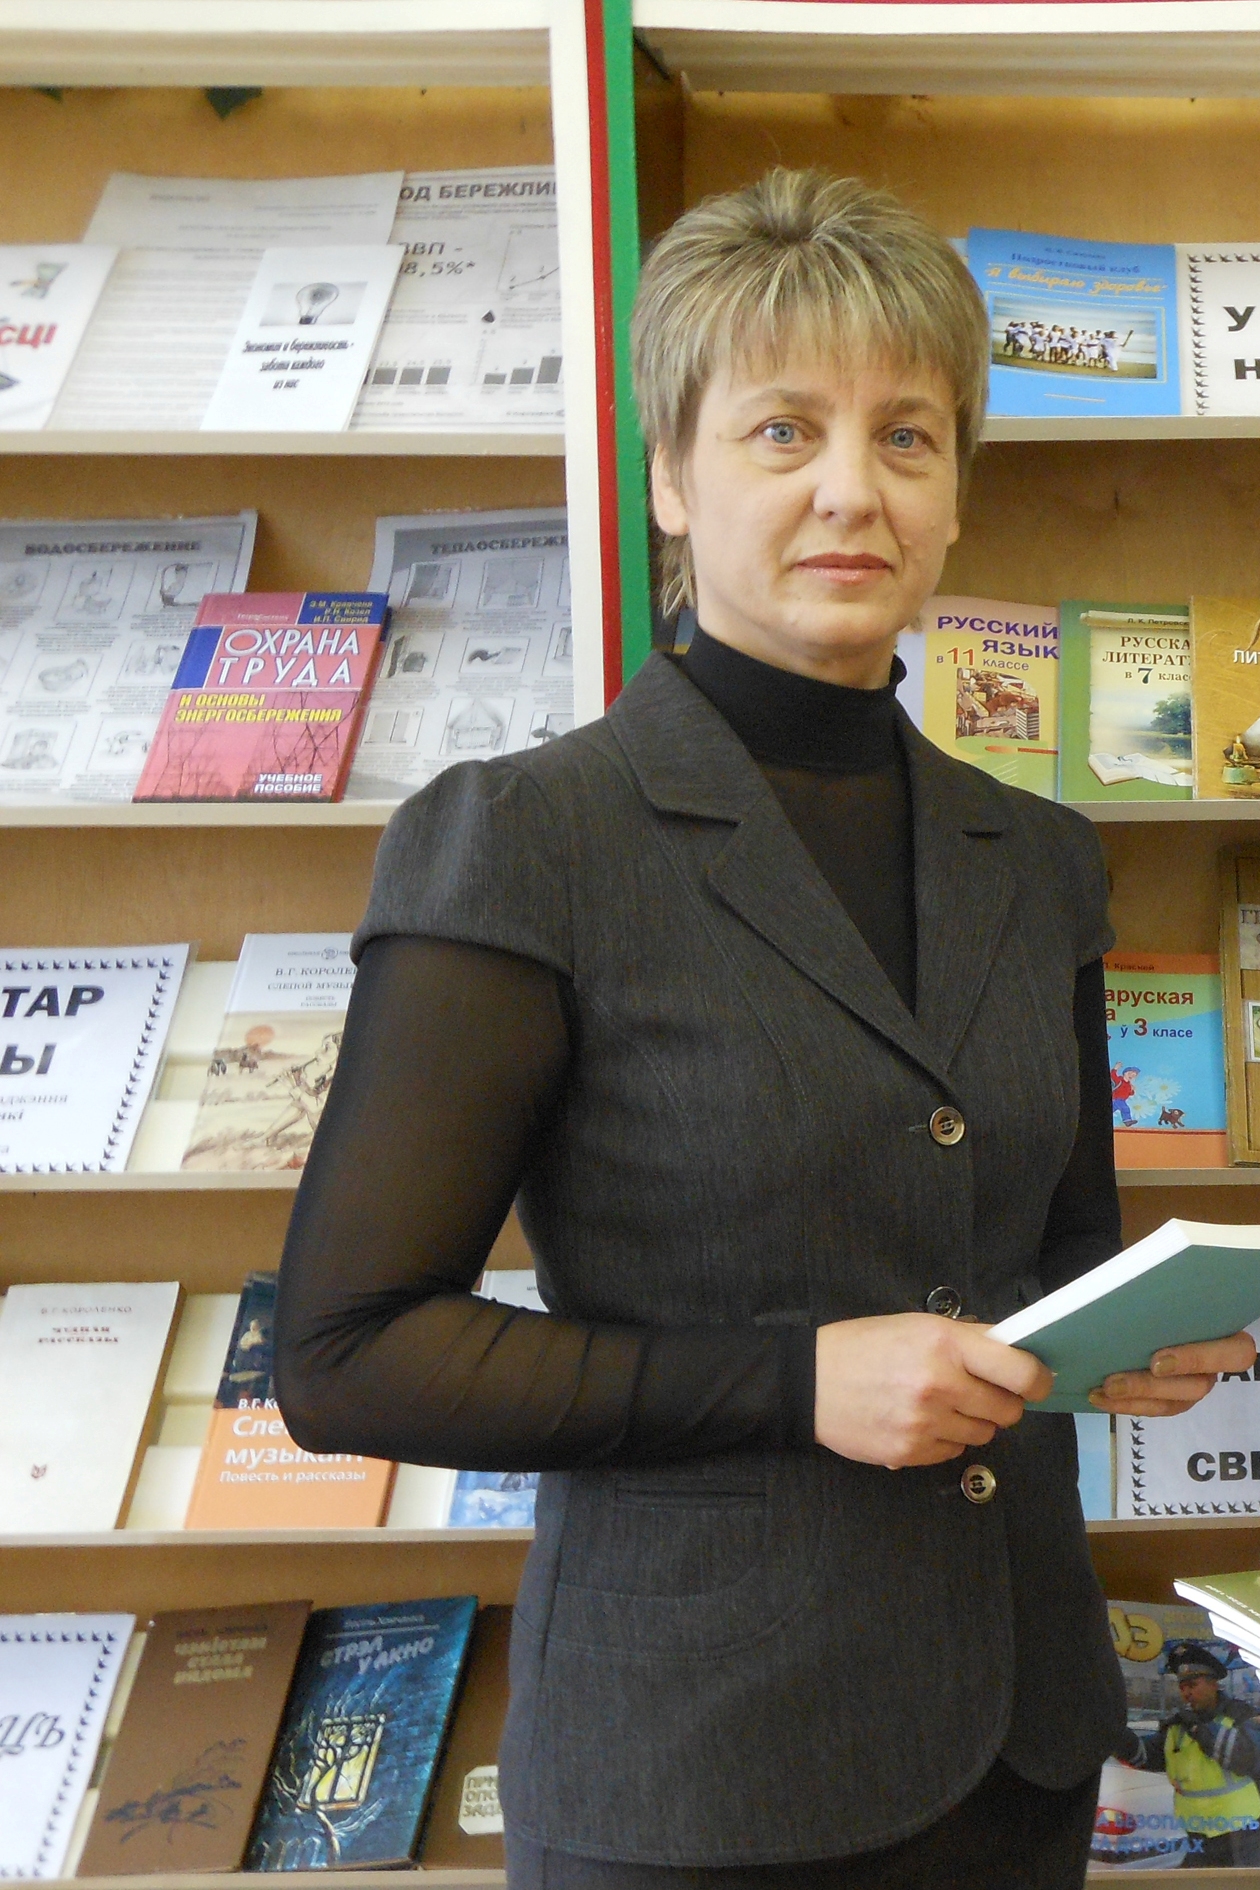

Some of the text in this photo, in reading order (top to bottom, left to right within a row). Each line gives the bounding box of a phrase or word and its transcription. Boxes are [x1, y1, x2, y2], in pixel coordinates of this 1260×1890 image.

[1223, 305, 1258, 332] У
[937, 615, 1058, 639] РУССКИЙ
[225, 628, 361, 656] ОХРАНА
[982, 639, 1060, 659] ЯЗЫК
[946, 647, 974, 666] 11
[982, 658, 1029, 671] классе
[1102, 651, 1191, 667] ЛИТЕРАТ
[217, 657, 352, 687] ТРУДА
[1138, 667, 1153, 684] 7
[179, 693, 266, 707] И ОСНОВЫ
[174, 708, 343, 724] ЭНЕРГОСБЕРЕЖЕНИЯ
[253, 783, 323, 794] ПОСОБИЕ
[258, 773, 323, 784] УЧЕБНОЕ
[2, 985, 105, 1018] ТАР
[1104, 988, 1194, 1008] аруская
[1134, 1017, 1148, 1036] 3
[1152, 1027, 1193, 1038] класе
[219, 1470, 366, 1483] Повесть и рассказы
